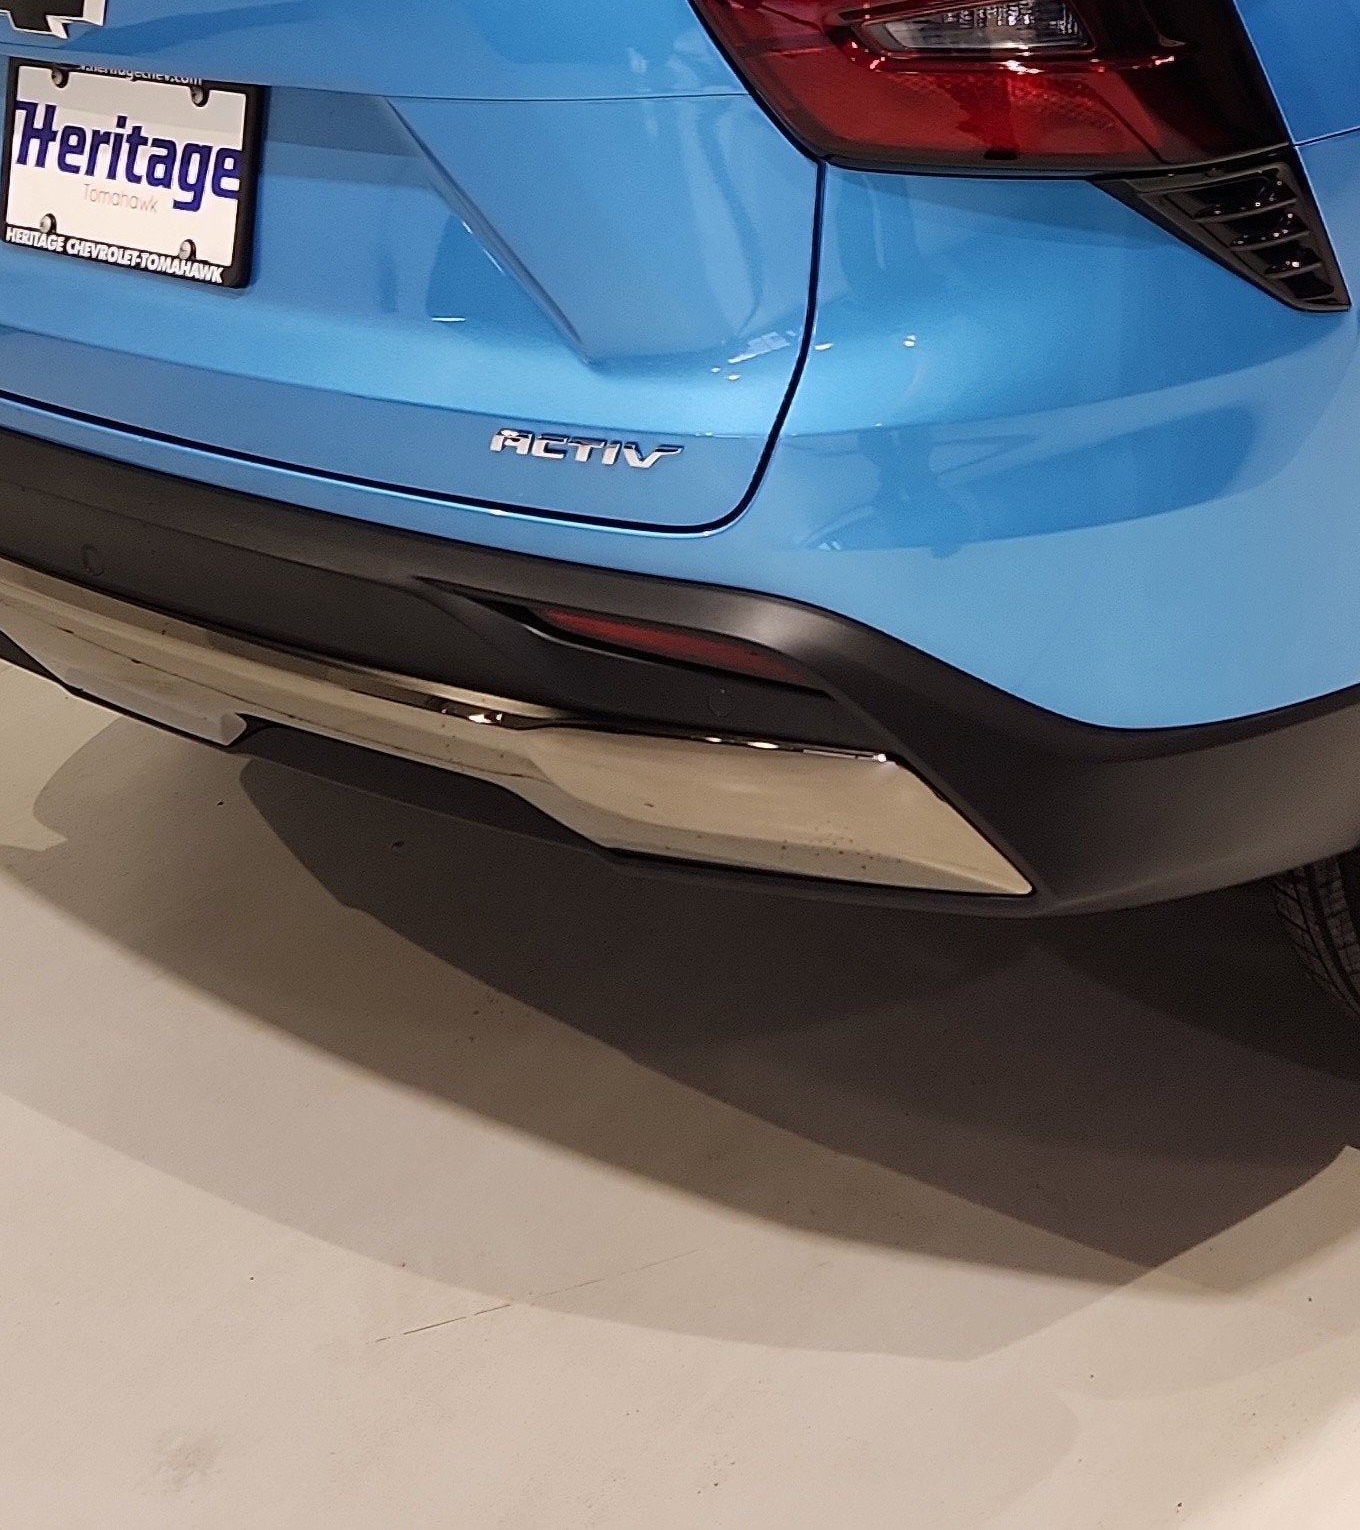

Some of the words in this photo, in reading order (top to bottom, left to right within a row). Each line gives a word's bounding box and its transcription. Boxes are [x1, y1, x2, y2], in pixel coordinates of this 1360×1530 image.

[15, 101, 242, 212] Heritage
[83, 183, 159, 214] Tomahawk
[5, 227, 66, 253] HERITAGE
[66, 238, 224, 284] CHEVROLET-TOMAHAWK
[490, 427, 684, 469] ACTIV
